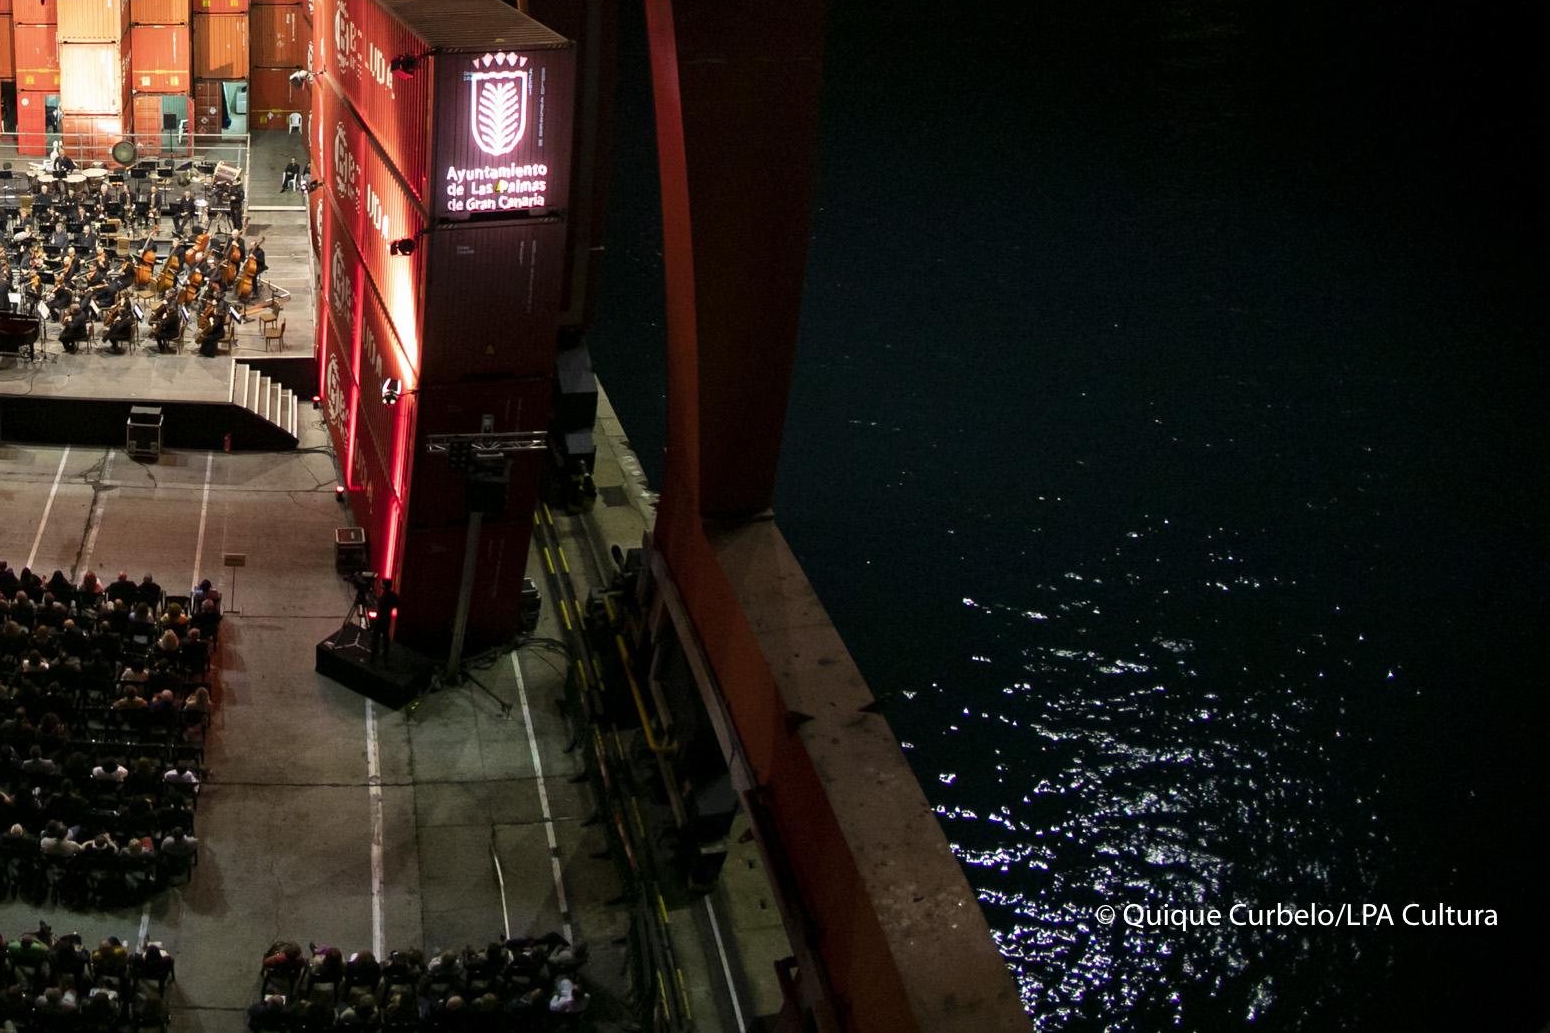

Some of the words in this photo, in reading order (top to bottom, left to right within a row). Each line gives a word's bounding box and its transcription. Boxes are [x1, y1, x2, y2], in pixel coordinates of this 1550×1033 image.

[447, 162, 548, 184] Ayuntamiento
[447, 183, 465, 196] de
[471, 181, 494, 196] Las
[499, 179, 547, 194] Palmas
[448, 198, 464, 212] de
[466, 197, 497, 211] Gran
[498, 192, 545, 210] Canaria
